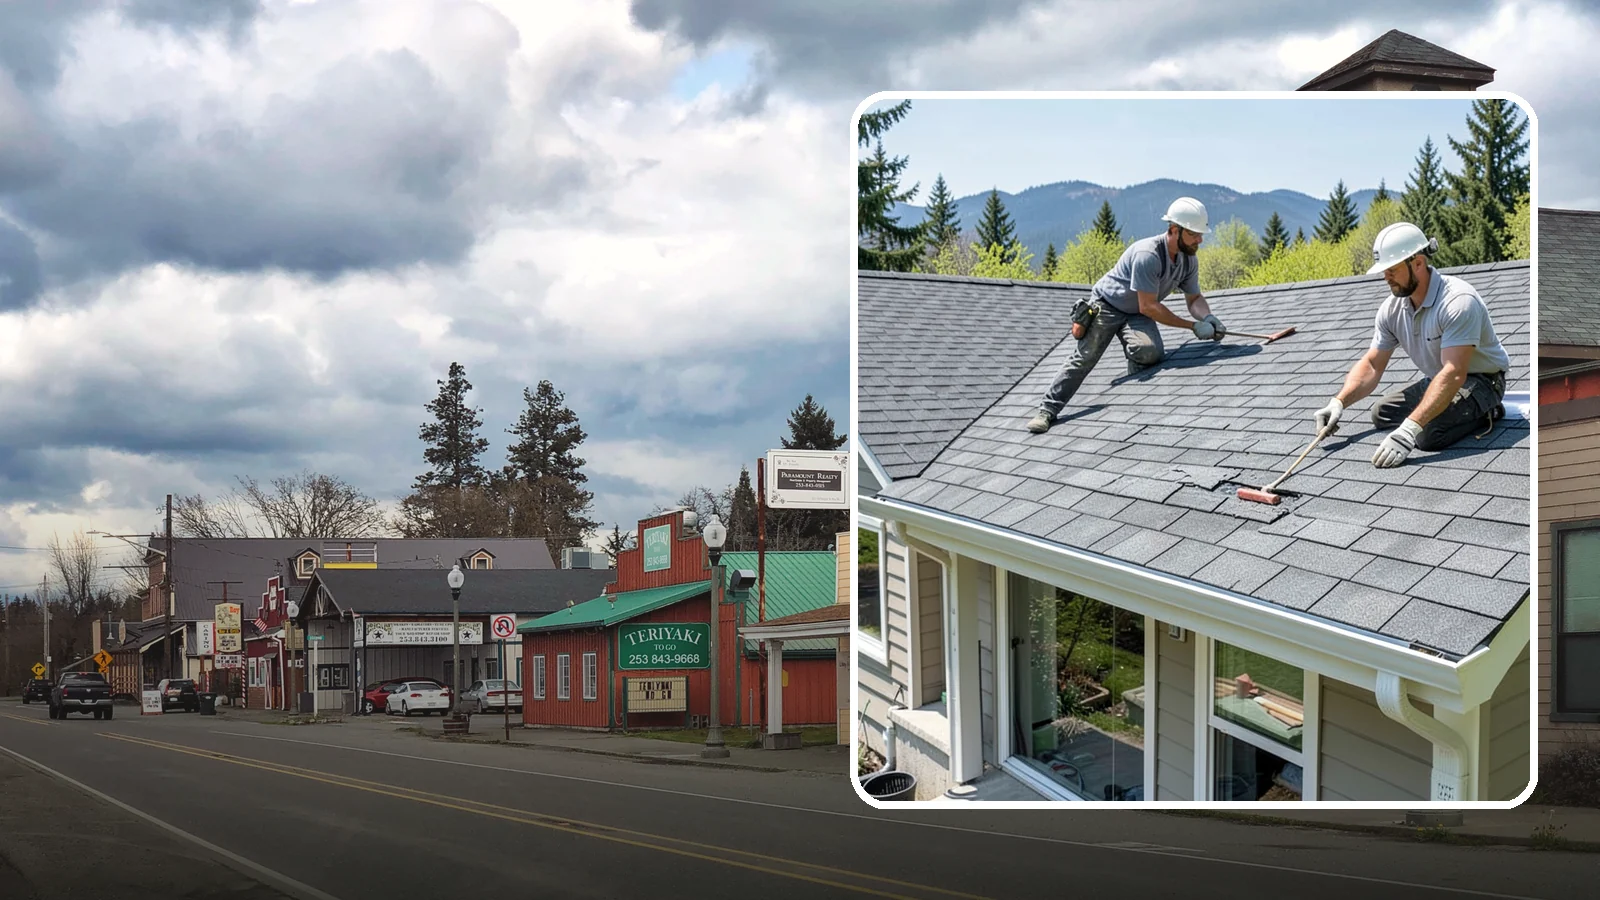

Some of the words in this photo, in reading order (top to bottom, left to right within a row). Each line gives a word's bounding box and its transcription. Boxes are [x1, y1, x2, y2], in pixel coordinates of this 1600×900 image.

[817, 472, 839, 480] REALTY
[624, 627, 703, 646] TERIYAKI
[628, 654, 649, 665] 253
[651, 653, 700, 664] 843-9668
